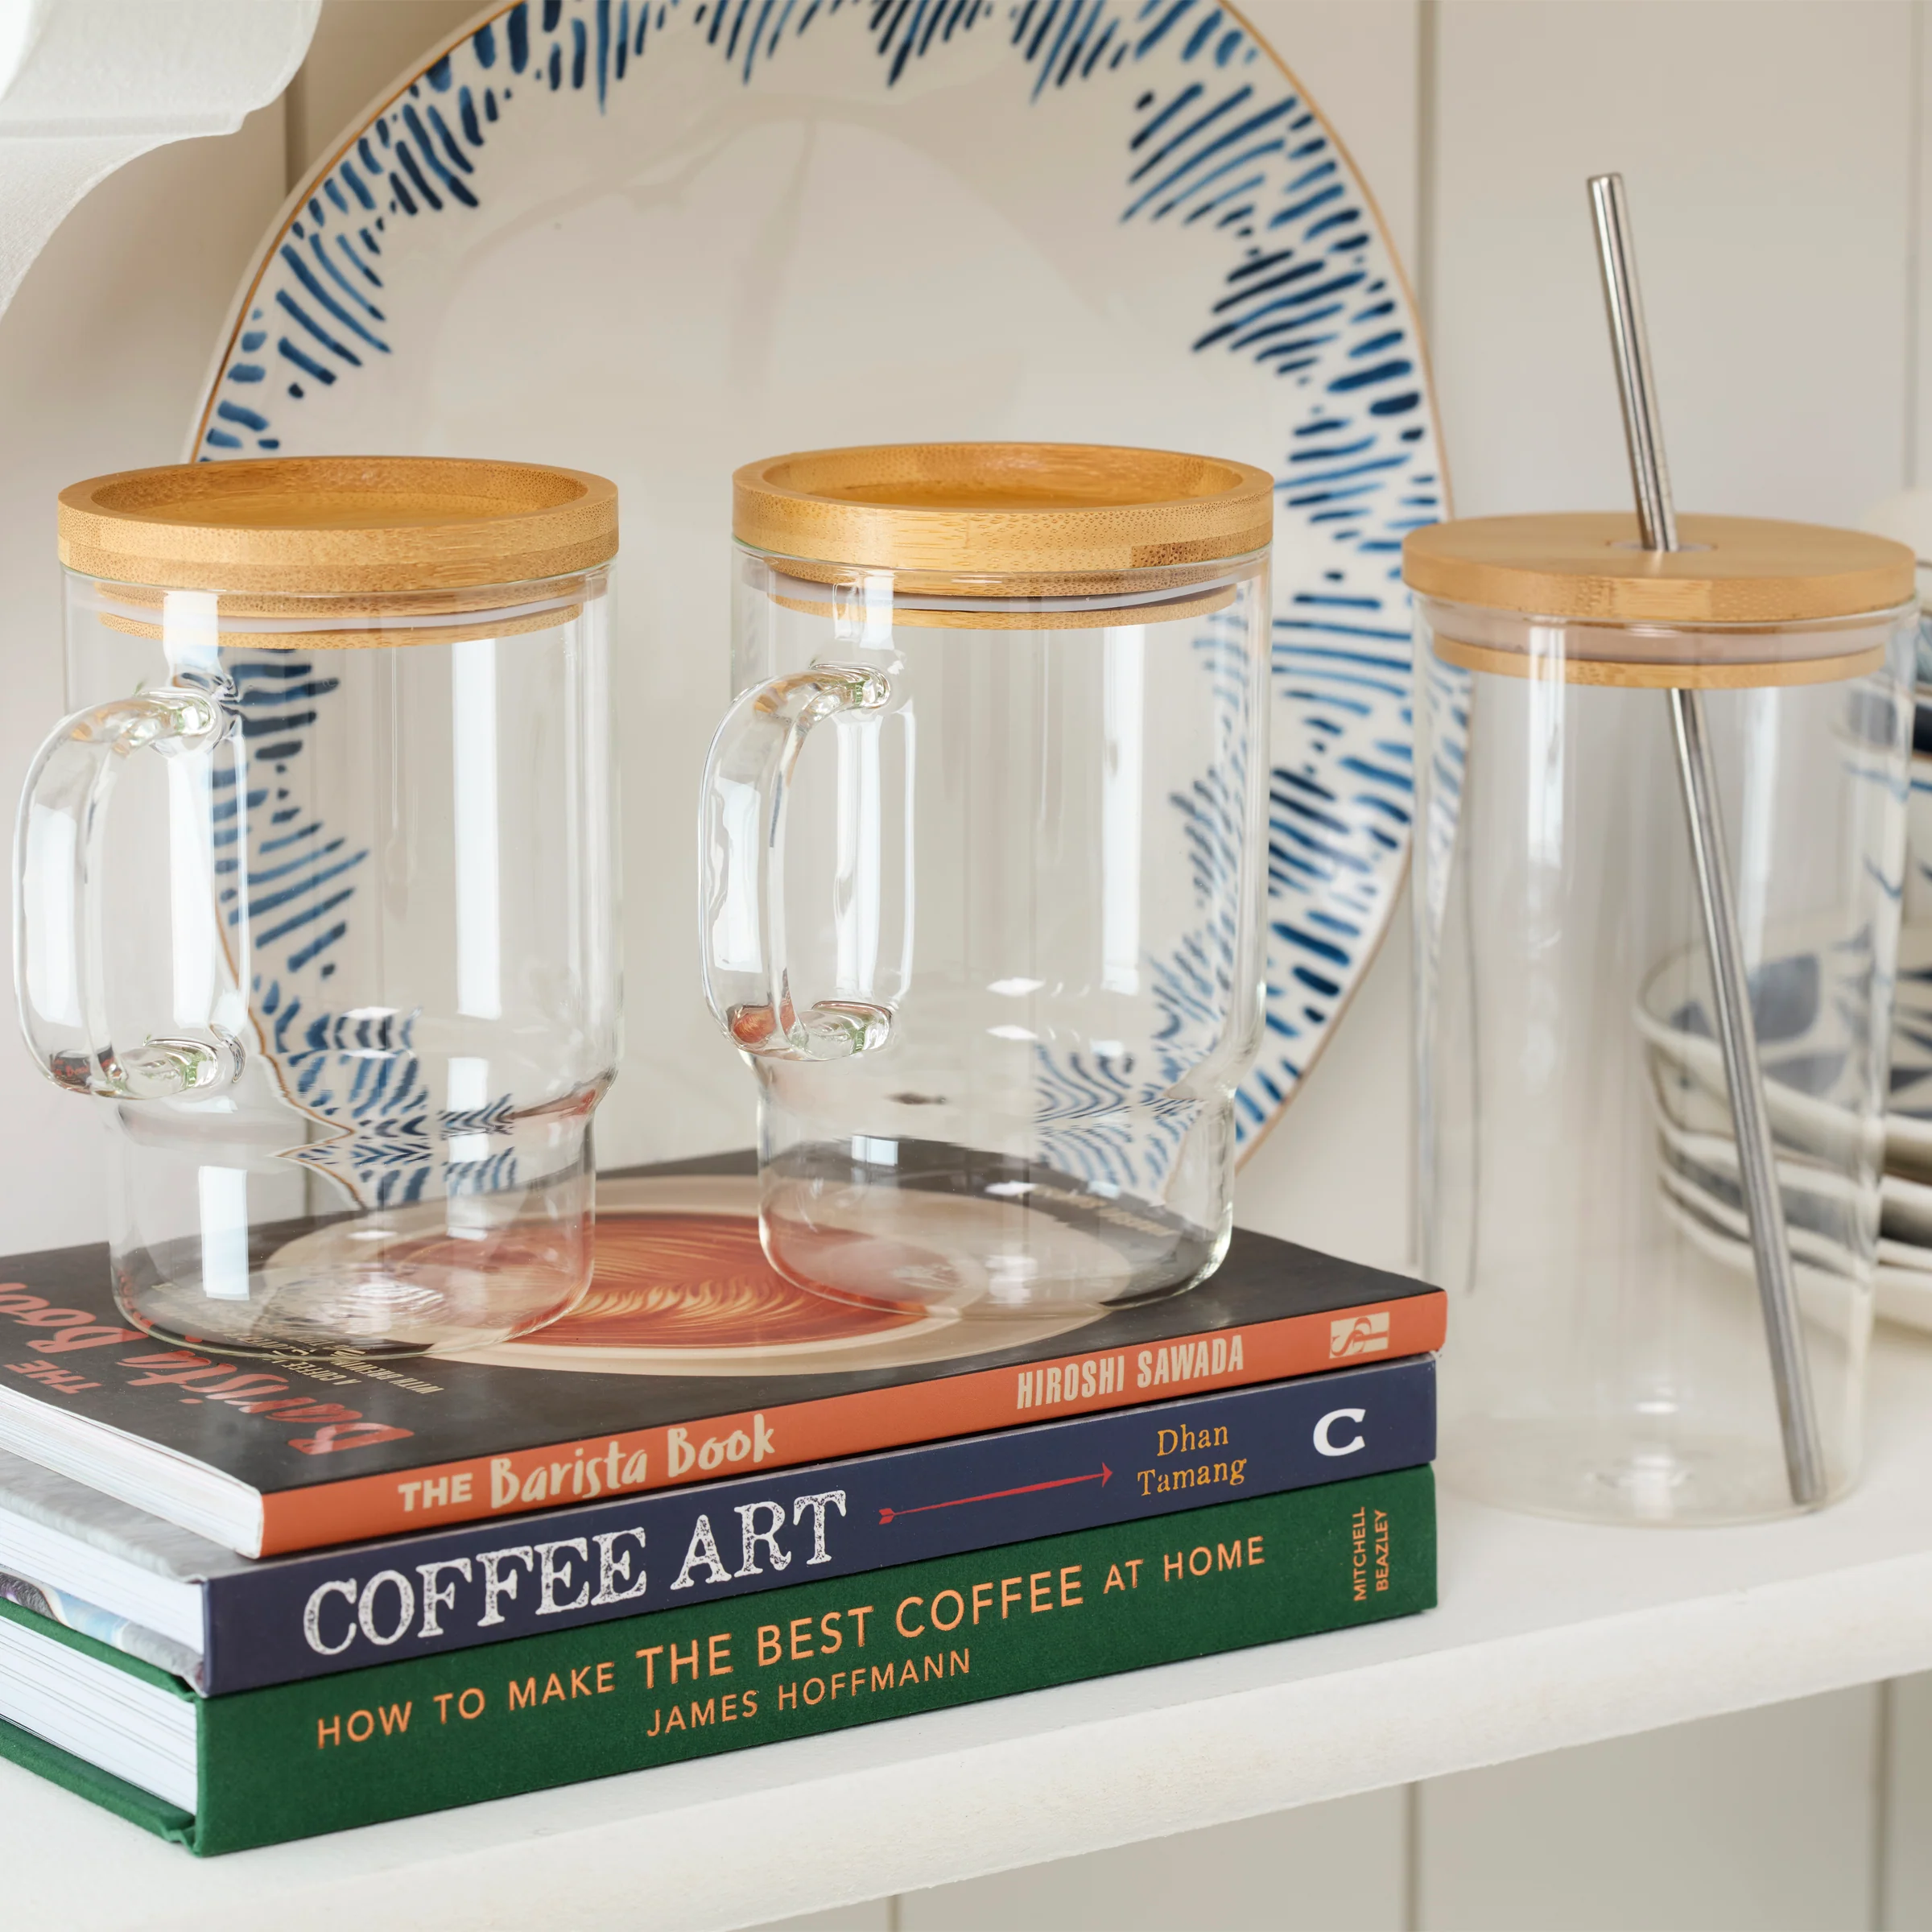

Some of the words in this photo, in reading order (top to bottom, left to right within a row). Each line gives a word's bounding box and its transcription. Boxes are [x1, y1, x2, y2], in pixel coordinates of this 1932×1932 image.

[0, 1282, 151, 1354] Boo
[6, 1360, 101, 1395] THE
[118, 1350, 415, 1455] Barista
[280, 1359, 346, 1381] COFFEE
[395, 1377, 445, 1394] WITH
[398, 1472, 473, 1511] THE
[490, 1443, 647, 1509] Barista
[667, 1413, 775, 1477] Book
[1017, 1355, 1125, 1410] HIROSHI
[1137, 1335, 1244, 1388] SAWADA
[1157, 1423, 1228, 1456] Dhan
[1313, 1408, 1366, 1456] C
[1137, 1458, 1247, 1496] Tamang
[303, 1526, 647, 1655] COFFEE
[670, 1489, 847, 1591] ART
[1352, 1507, 1367, 1601] MITCHELL
[1374, 1510, 1389, 1591] BEAZLEY
[318, 1701, 412, 1748] HOW
[433, 1688, 485, 1723] TO
[509, 1662, 613, 1711] MAKE
[635, 1633, 733, 1689] THE
[758, 1605, 874, 1666] BEST
[895, 1565, 1084, 1638] COFFEE
[1104, 1559, 1143, 1594] AT
[1163, 1535, 1265, 1582] HOME
[646, 1690, 758, 1736] JAMES
[778, 1648, 969, 1711] HOFFMANN
